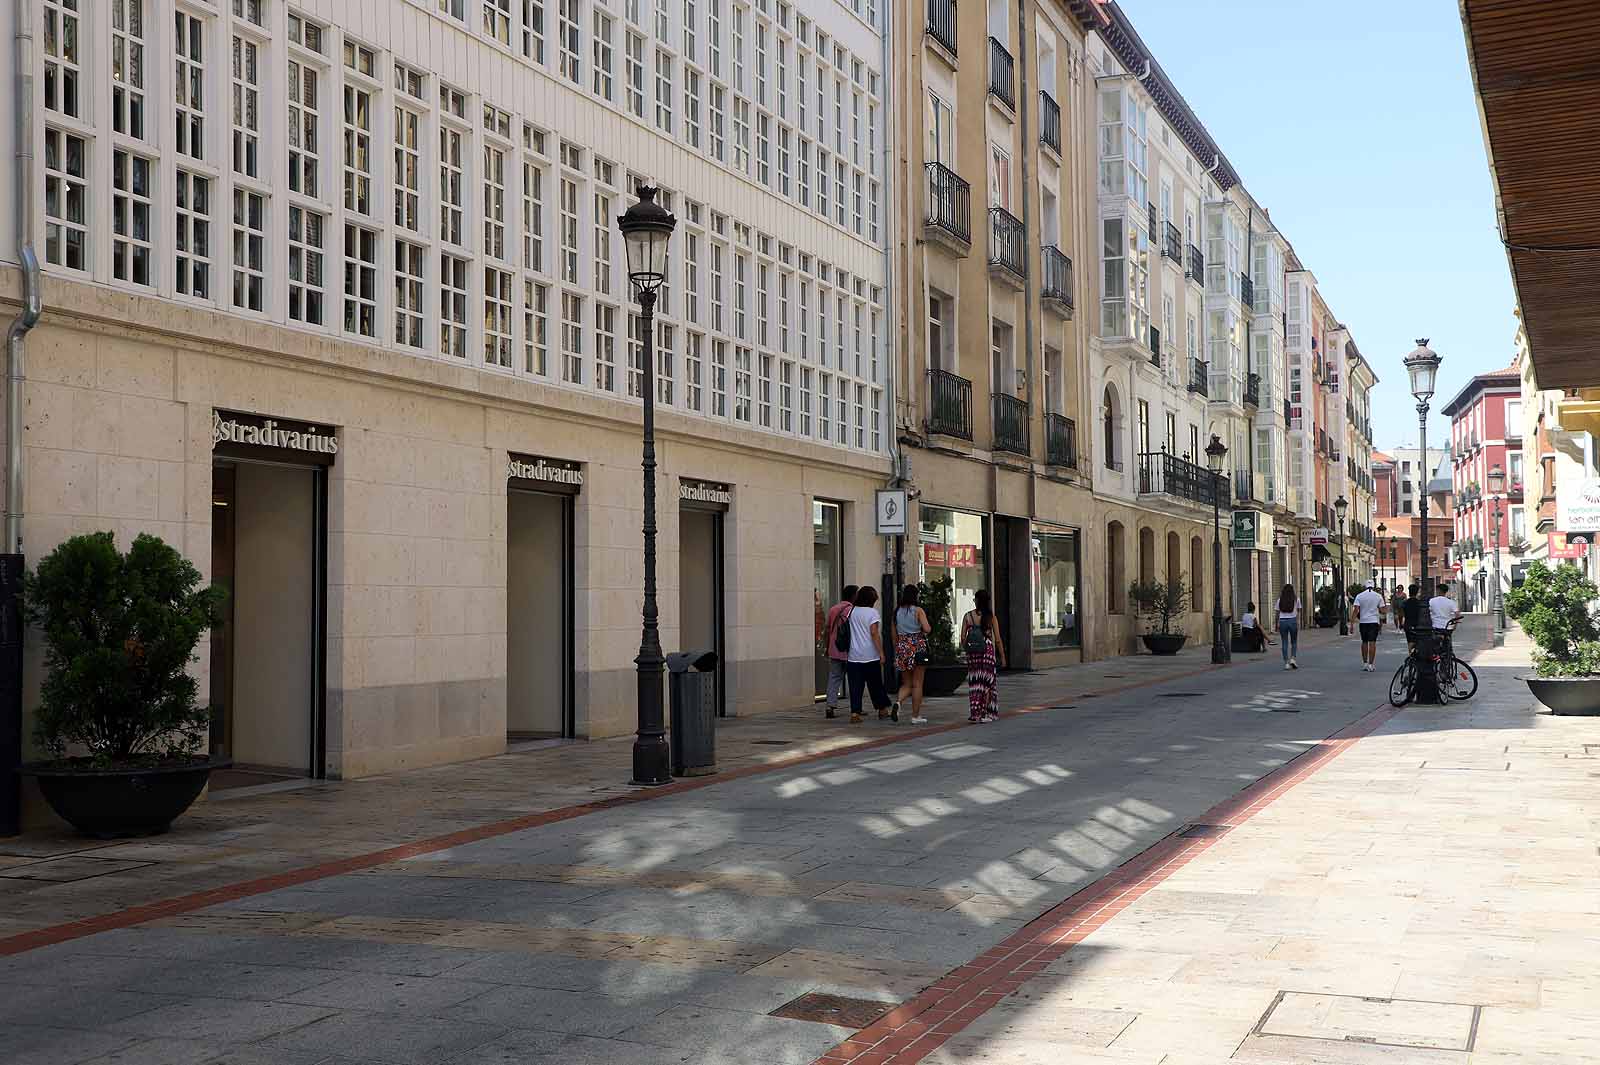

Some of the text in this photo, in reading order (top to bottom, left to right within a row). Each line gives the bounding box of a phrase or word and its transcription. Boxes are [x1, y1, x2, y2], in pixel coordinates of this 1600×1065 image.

[218, 418, 338, 454] stradivarius
[508, 457, 584, 486] stradivarius
[679, 481, 731, 505] stradivarius
